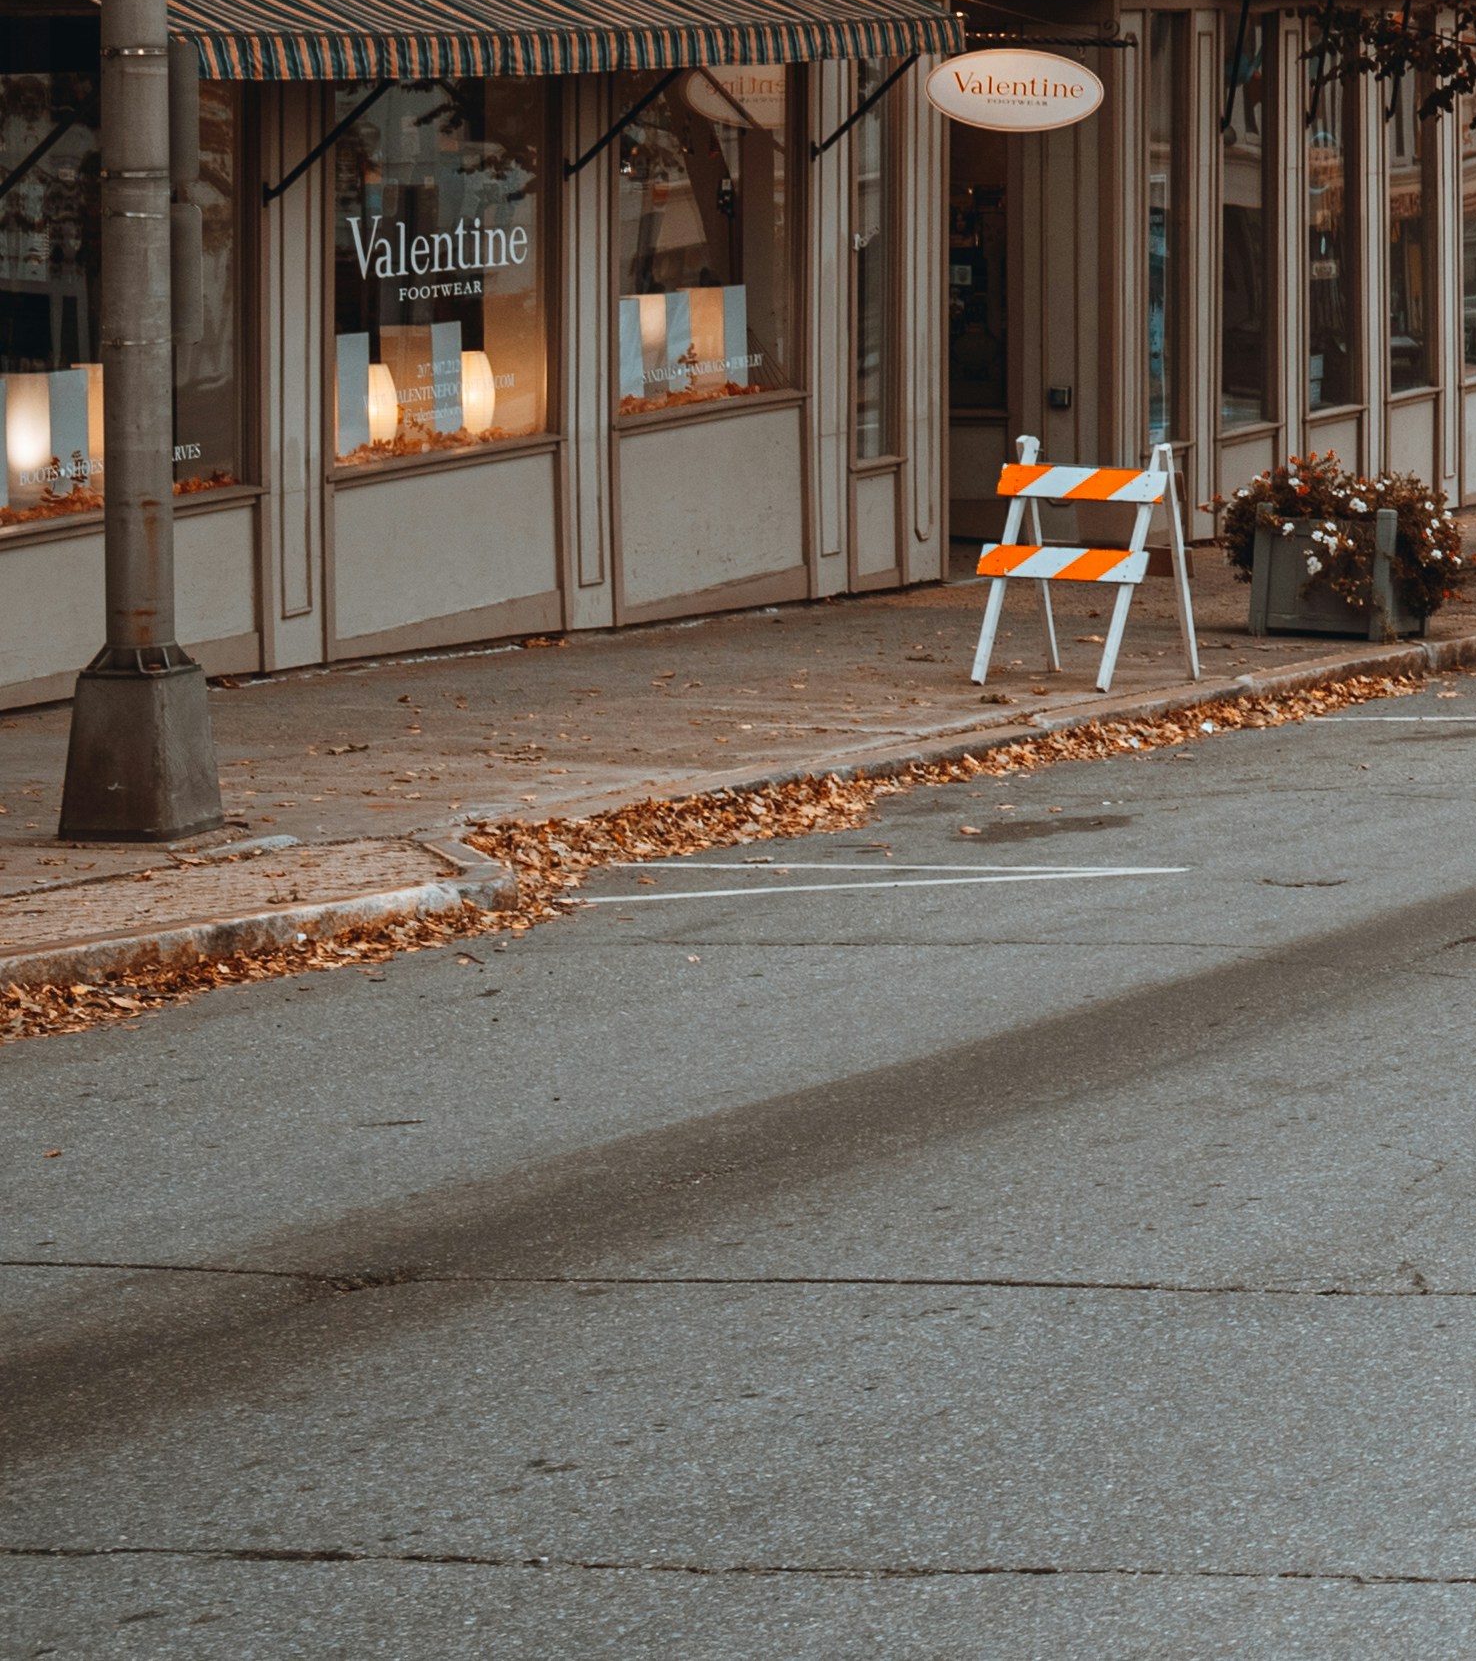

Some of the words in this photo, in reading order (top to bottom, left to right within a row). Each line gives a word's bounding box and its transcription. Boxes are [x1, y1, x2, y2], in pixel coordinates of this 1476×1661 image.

[954, 71, 1084, 100] Valentine
[987, 98, 1049, 107] FOOTWEAR
[346, 215, 528, 280] Valentine
[399, 280, 483, 301] FOOTWEAR
